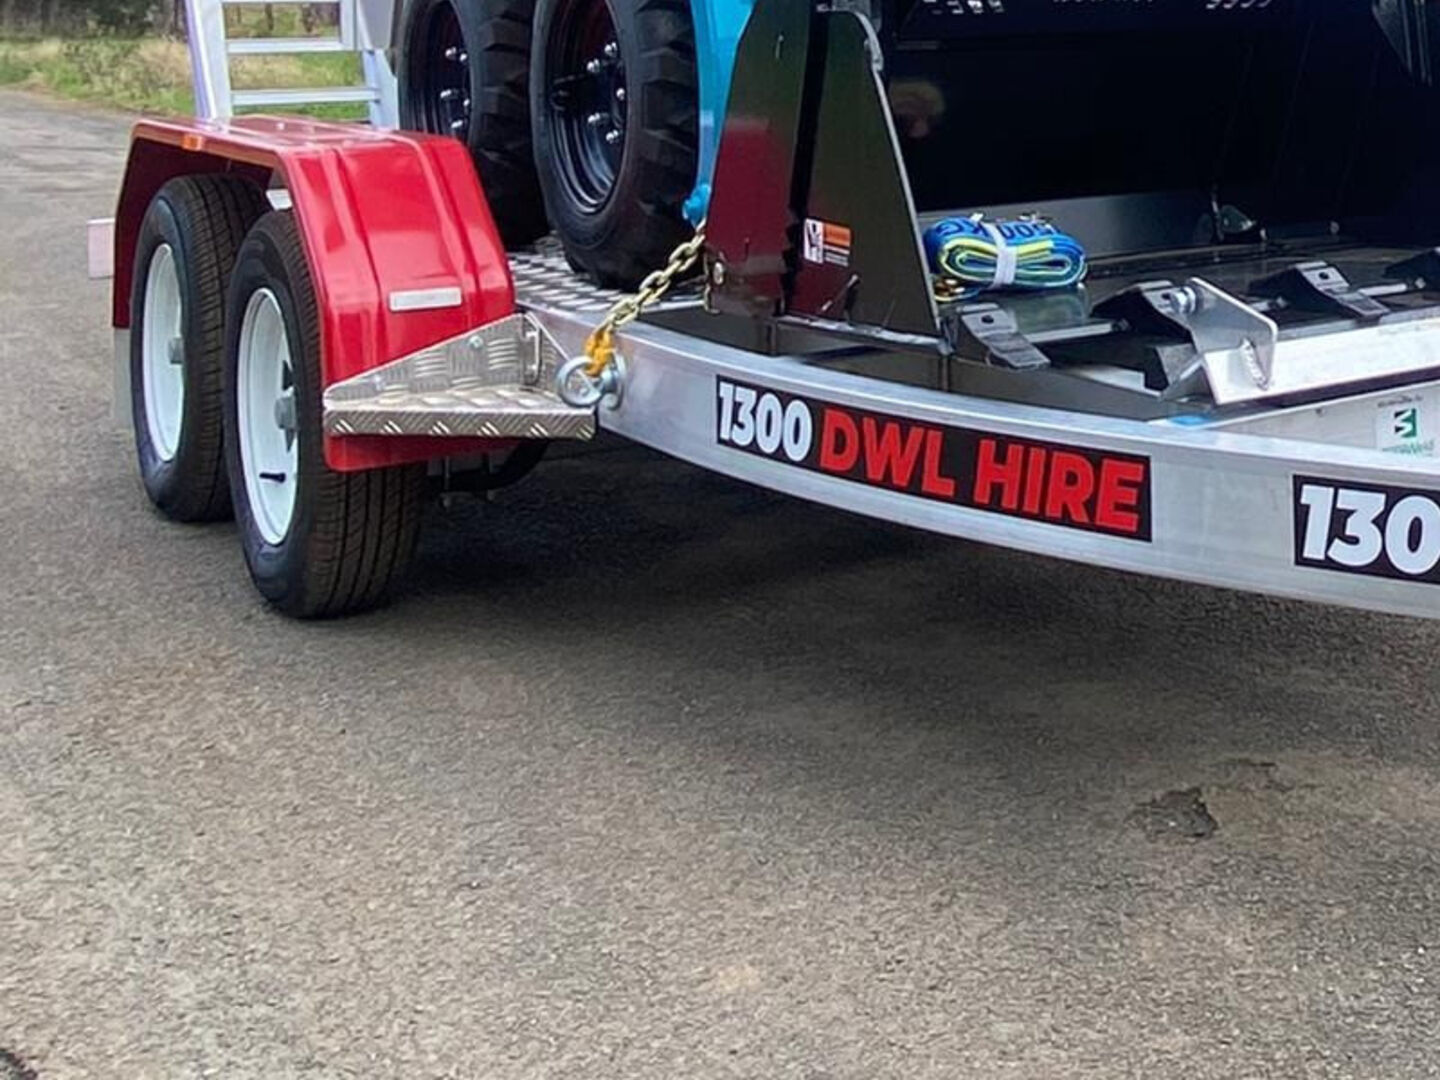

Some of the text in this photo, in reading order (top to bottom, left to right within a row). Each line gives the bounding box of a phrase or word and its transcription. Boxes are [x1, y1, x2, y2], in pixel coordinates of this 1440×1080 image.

[719, 383, 1144, 533] 1300 DWL HIRE
